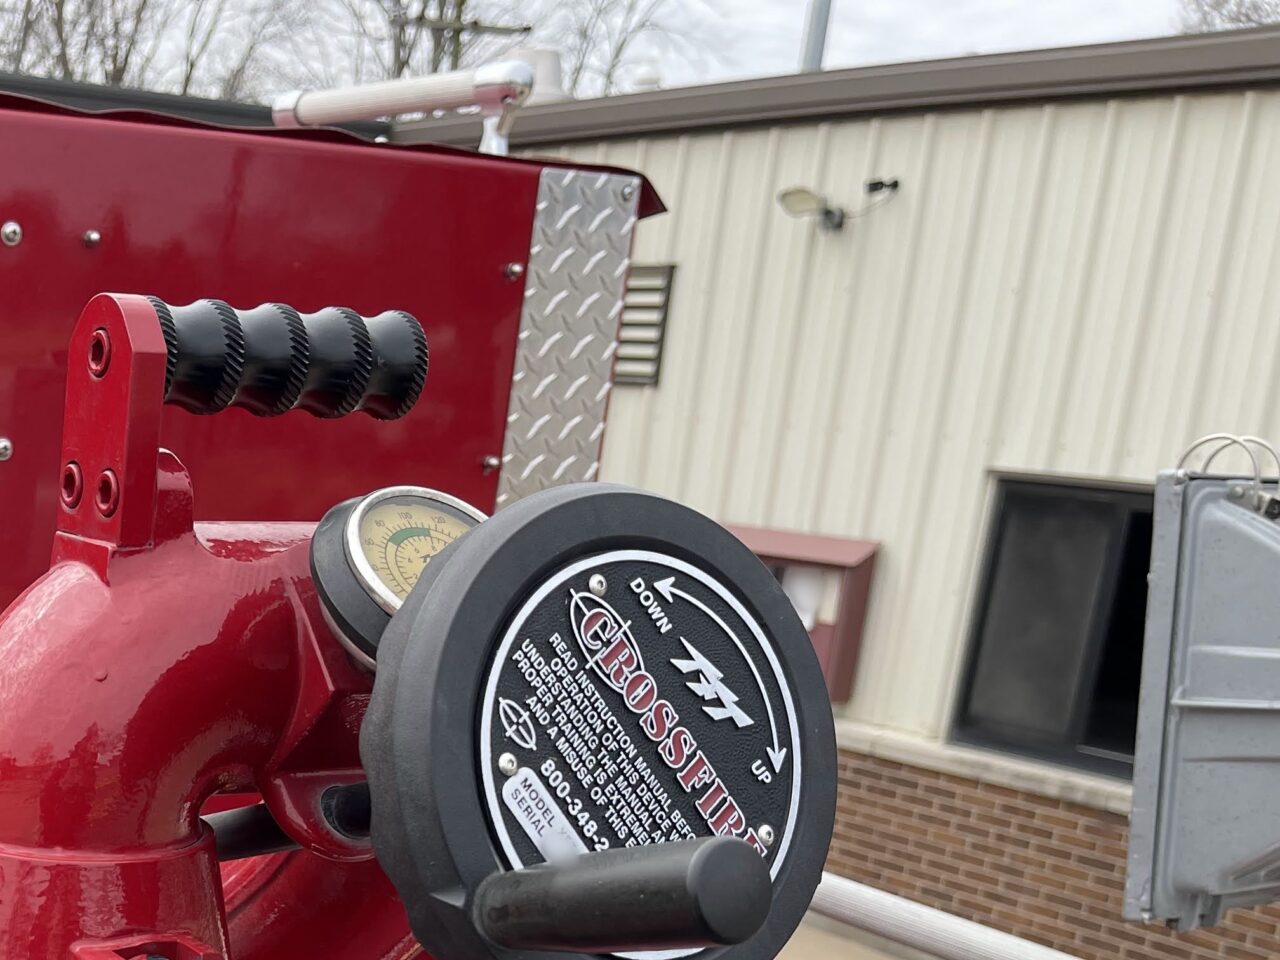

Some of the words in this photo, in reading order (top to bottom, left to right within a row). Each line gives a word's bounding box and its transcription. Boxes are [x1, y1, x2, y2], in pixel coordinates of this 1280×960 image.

[630, 577, 672, 634] DOWN
[512, 650, 554, 707] PROPER
[551, 704, 596, 770] TRAINING
[593, 768, 607, 785] IS
[521, 638, 599, 750] UNDERSTANDING
[597, 747, 618, 778] THE
[615, 775, 653, 831] MANUAL
[526, 696, 550, 725] AND
[547, 726, 558, 739] A
[556, 737, 594, 788] MISUSE
[591, 787, 608, 806] OF
[605, 805, 629, 839] THIS
[549, 632, 578, 671] READ
[575, 670, 637, 758] INSTRUCTION
[634, 756, 672, 812] MANUAL
[551, 657, 604, 734] OPERATION
[602, 733, 619, 752] OF
[616, 751, 639, 785] THIS
[636, 783, 672, 832] DEVICE
[750, 760, 772, 784] UP
[511, 788, 546, 838] SERIAL
[520, 777, 555, 828] MODEL
